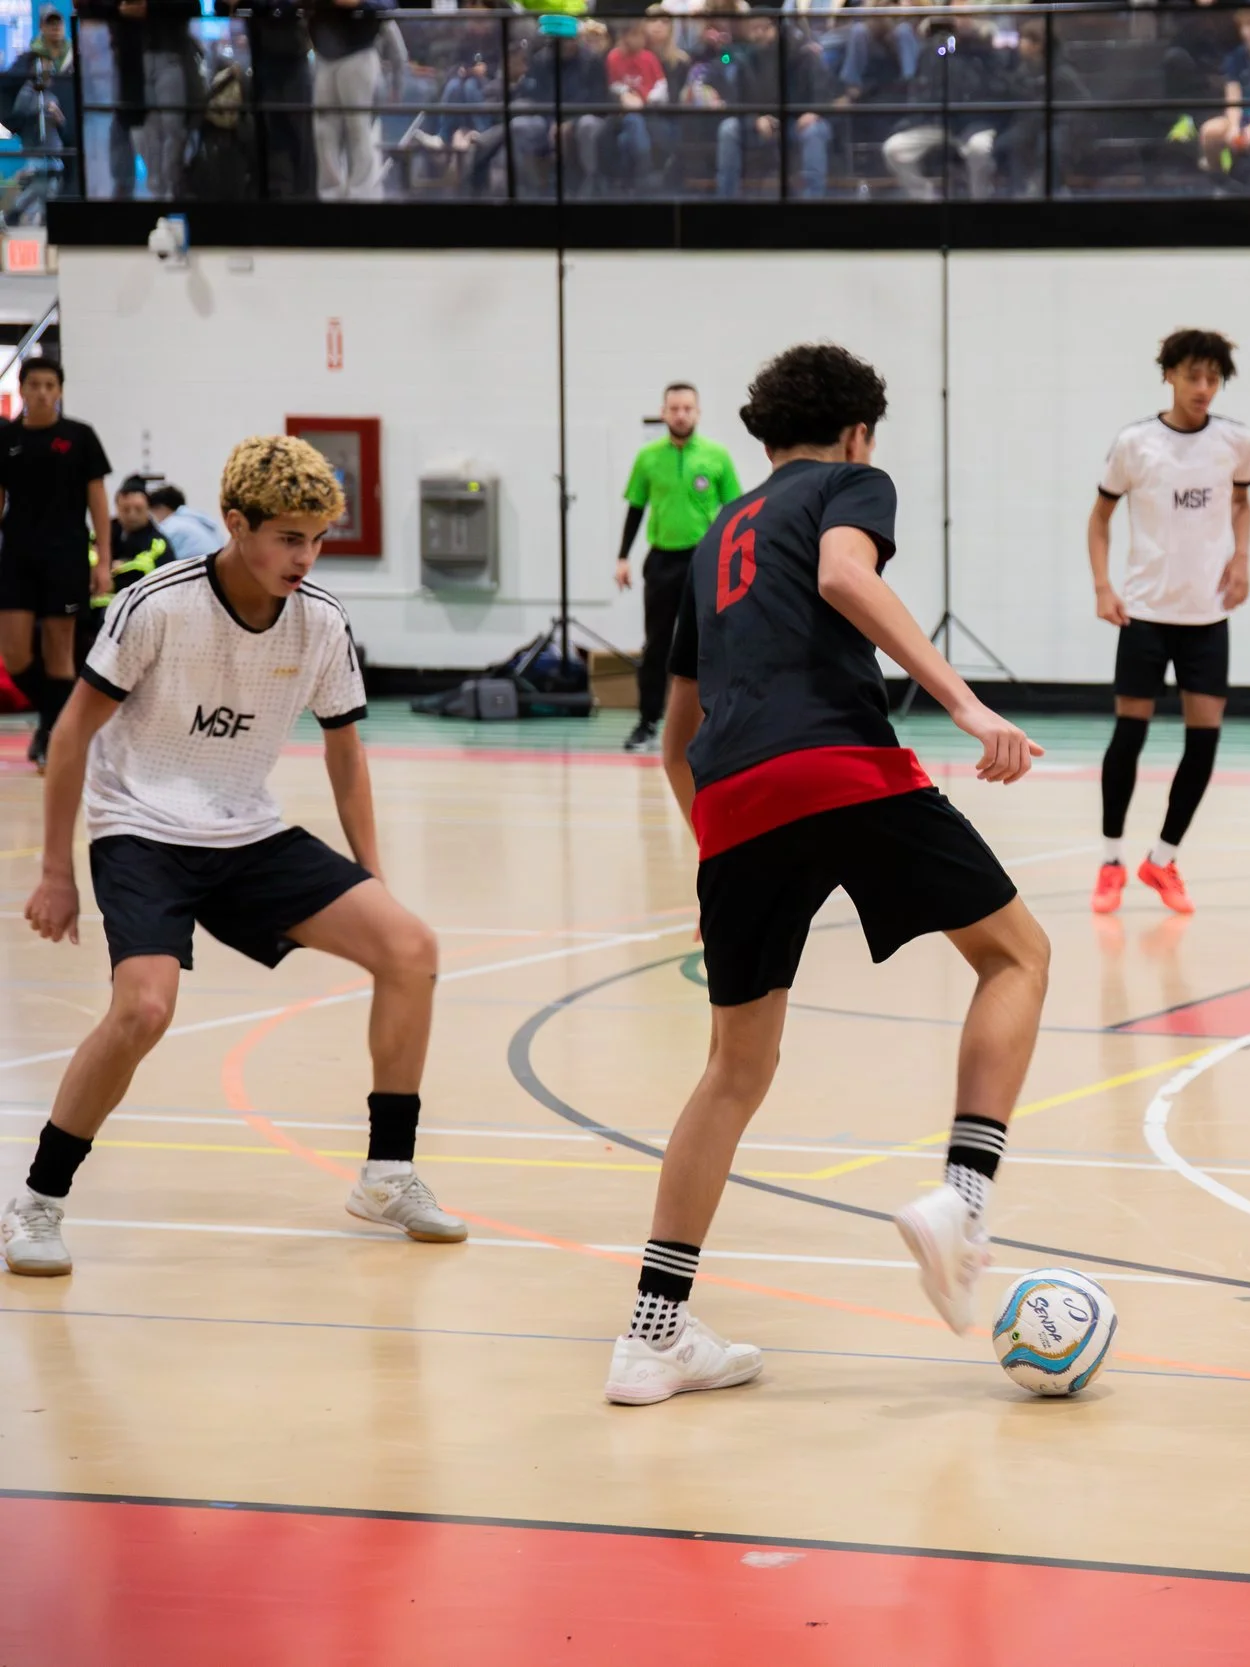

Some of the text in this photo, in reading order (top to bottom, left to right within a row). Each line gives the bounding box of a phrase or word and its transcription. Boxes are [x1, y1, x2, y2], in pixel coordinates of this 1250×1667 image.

[1173, 488, 1213, 510] MSF
[716, 496, 767, 614] 6
[189, 704, 255, 739] MSF
[1027, 1296, 1062, 1343] SENDA
